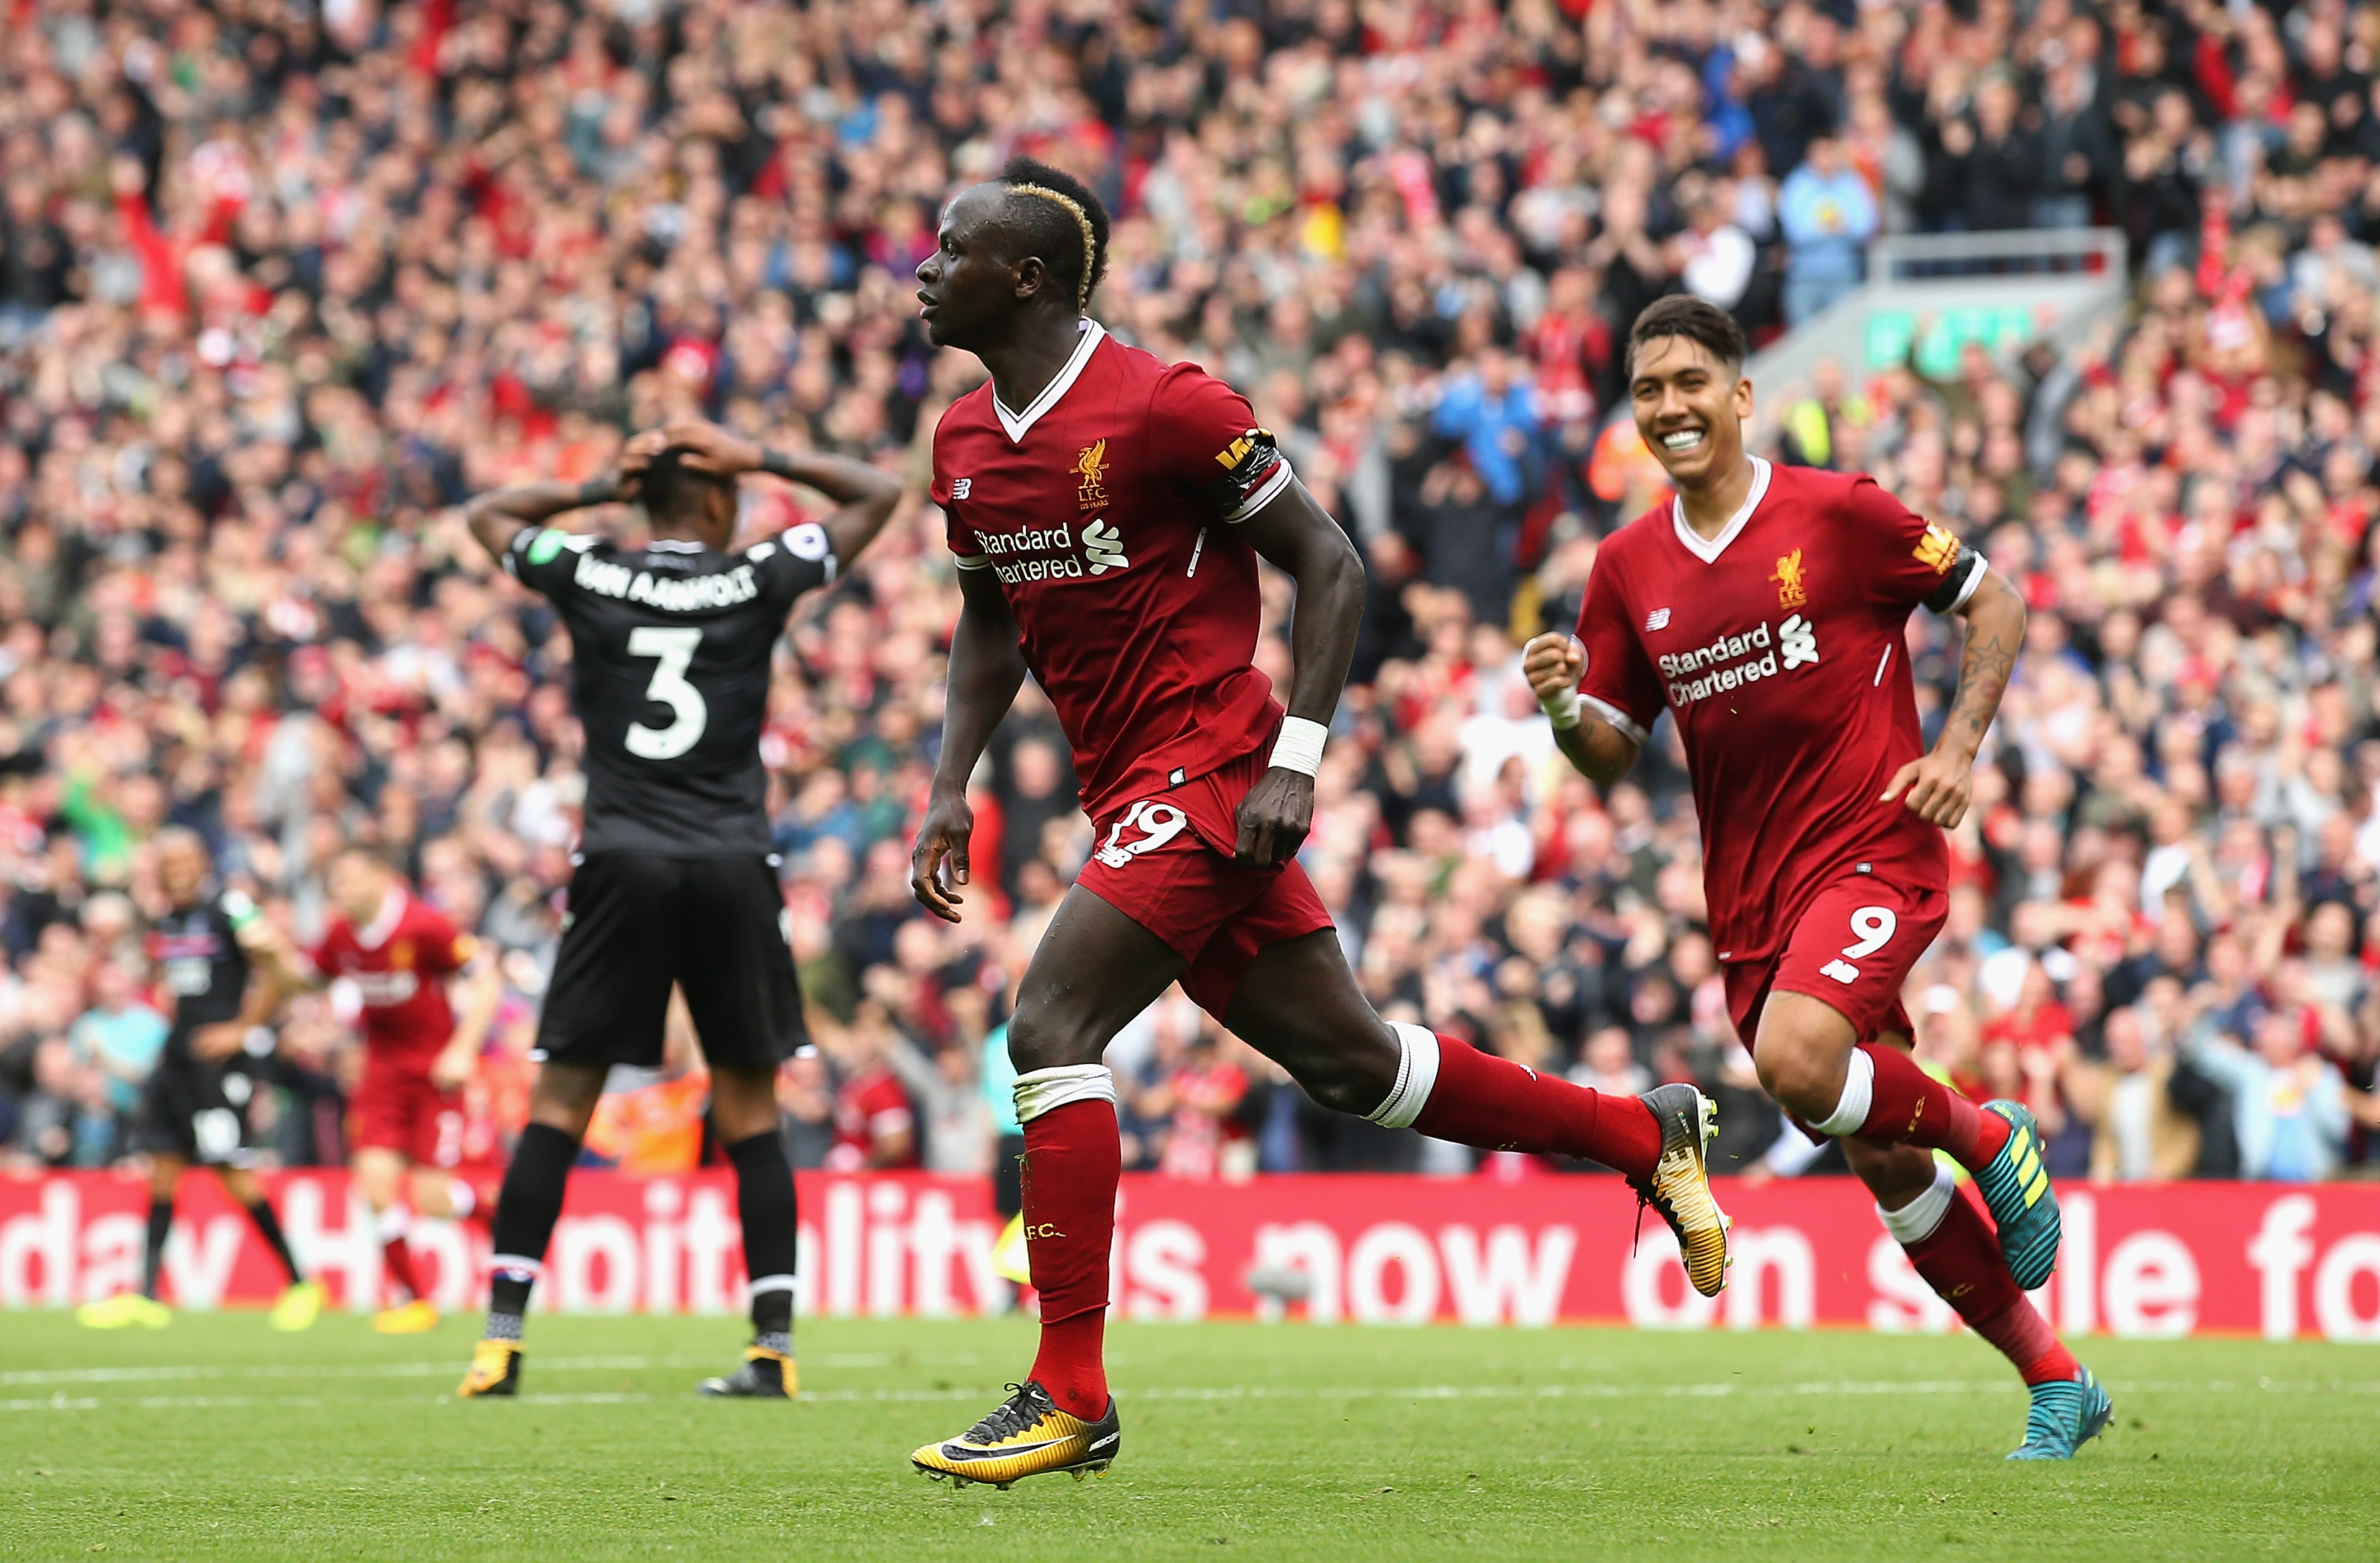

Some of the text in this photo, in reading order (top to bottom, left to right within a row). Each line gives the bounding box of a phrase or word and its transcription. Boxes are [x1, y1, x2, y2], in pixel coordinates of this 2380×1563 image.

[974, 522, 1072, 555] Standard
[991, 554, 1083, 584] hartered
[1658, 621, 1771, 679] Standard
[624, 627, 708, 761] 3
[1668, 650, 1778, 708] Chartered
[1103, 800, 1187, 855] 19
[1841, 906, 1897, 960] 9
[1249, 1219, 1579, 1328] now
[1622, 1222, 1818, 1331] on
[1866, 1190, 2202, 1339] sle
